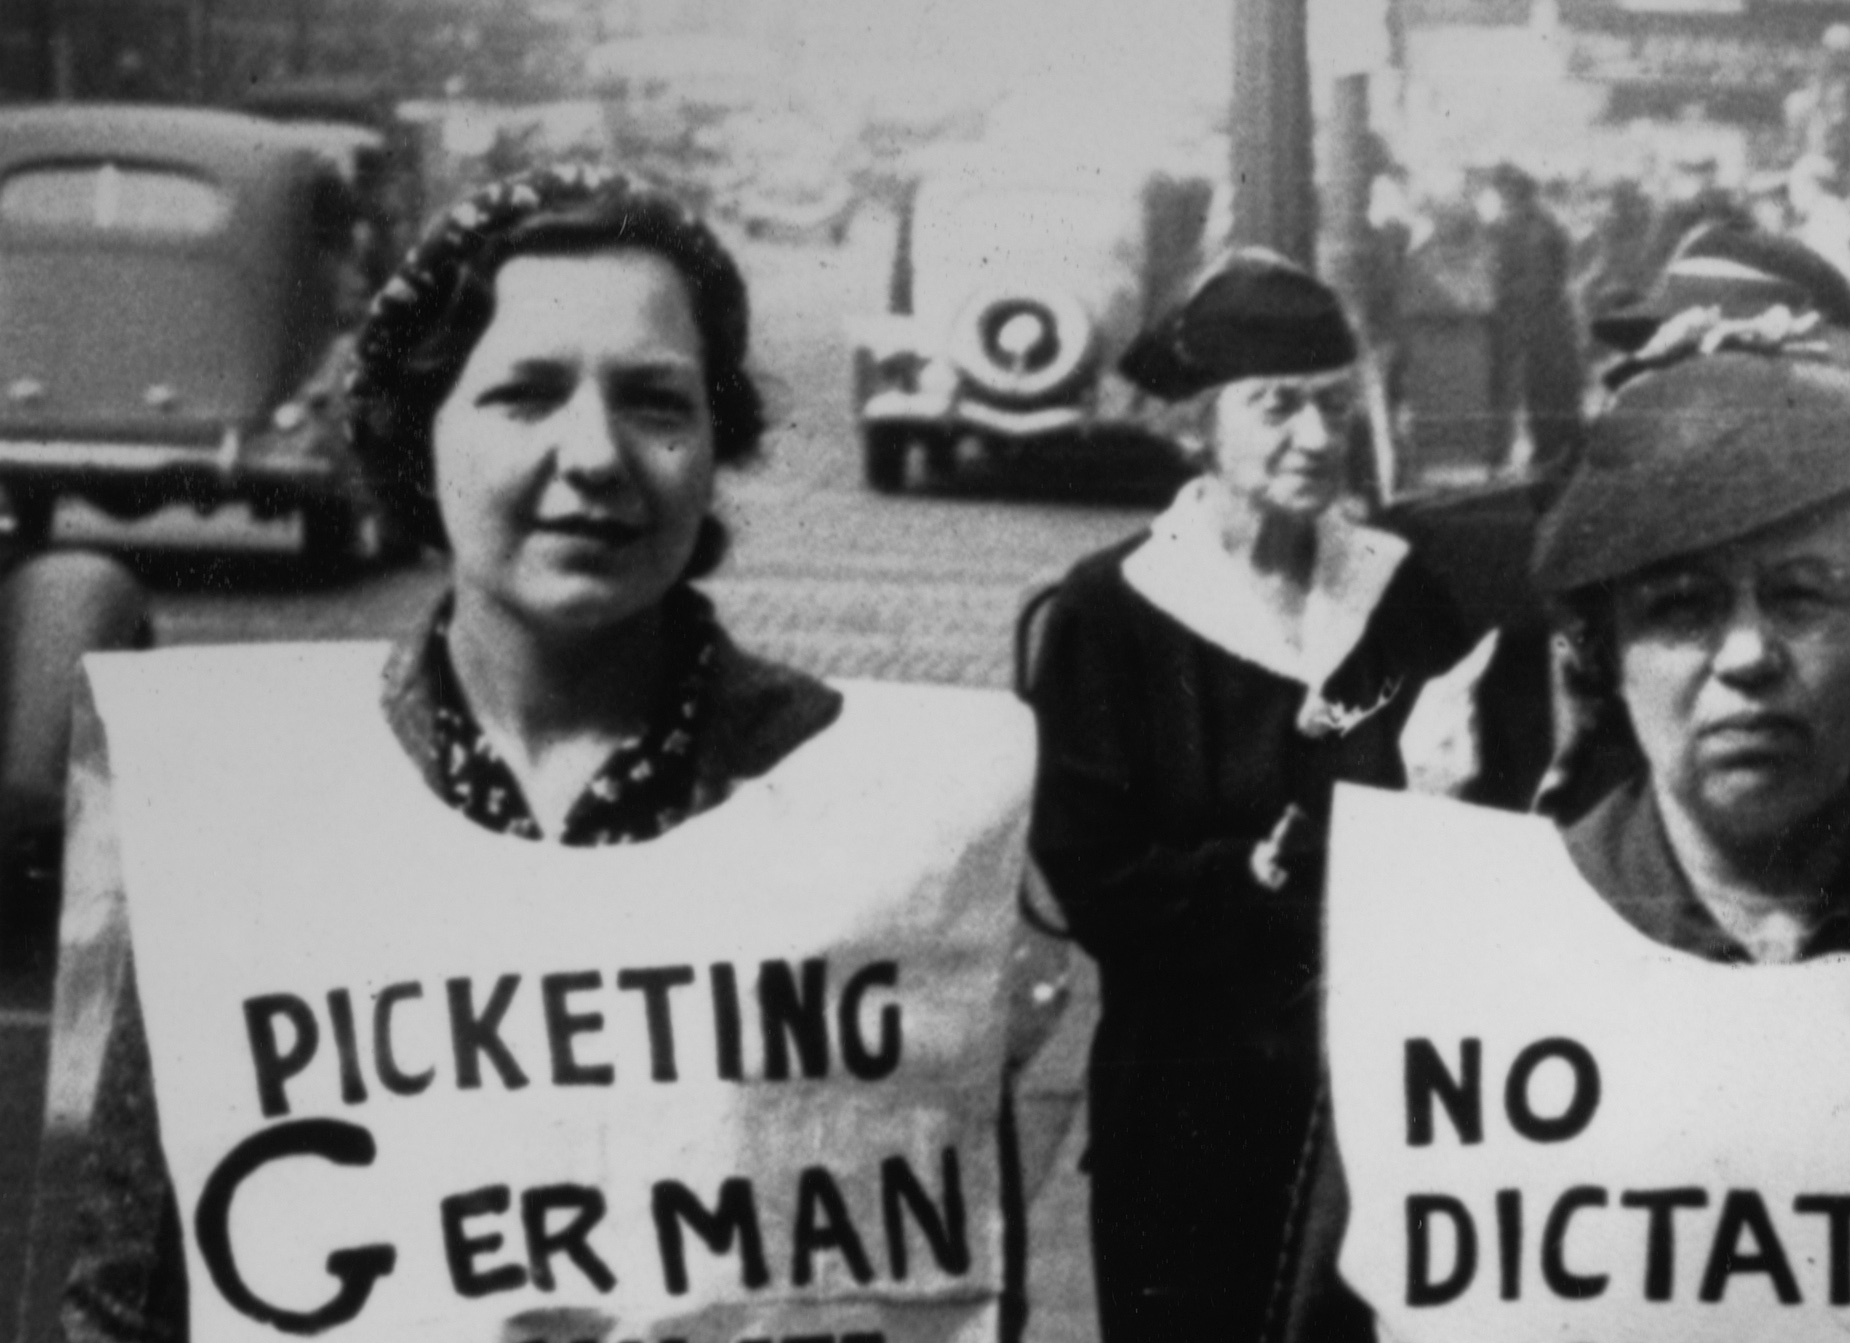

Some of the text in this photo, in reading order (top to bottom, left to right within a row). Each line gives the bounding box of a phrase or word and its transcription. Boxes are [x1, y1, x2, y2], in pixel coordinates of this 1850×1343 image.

[243, 957, 902, 1118] PICKETING
[1404, 1036, 1602, 1147] NO
[194, 1117, 971, 1337] GERMAN
